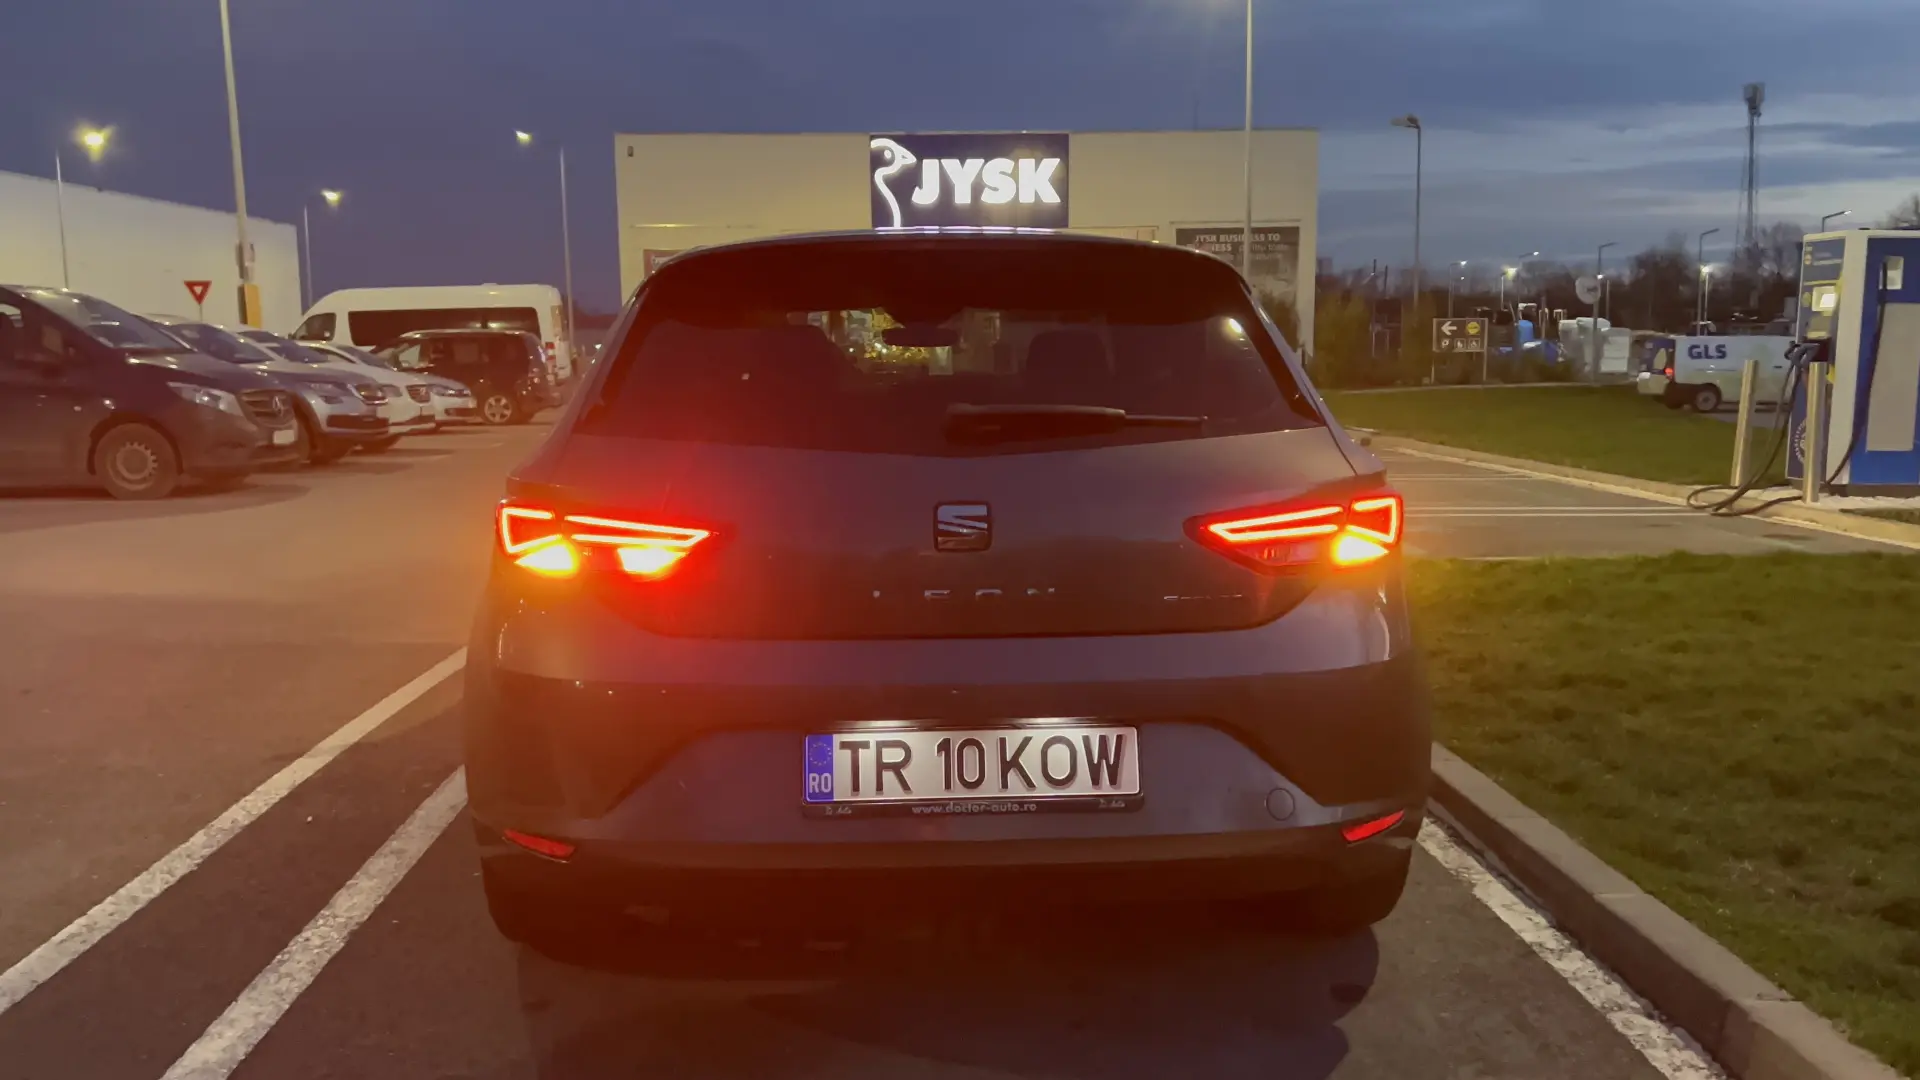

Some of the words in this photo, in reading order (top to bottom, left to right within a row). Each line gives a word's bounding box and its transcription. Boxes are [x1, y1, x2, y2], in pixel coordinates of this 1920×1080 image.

[911, 157, 1061, 204] JYSK
[1219, 233, 1265, 242] BUSISS
[1267, 232, 1280, 241] TO
[1687, 344, 1727, 360] GLS
[839, 739, 912, 793] TR
[936, 737, 986, 791] 10
[998, 734, 1124, 791] KOW
[808, 772, 832, 794] RO
